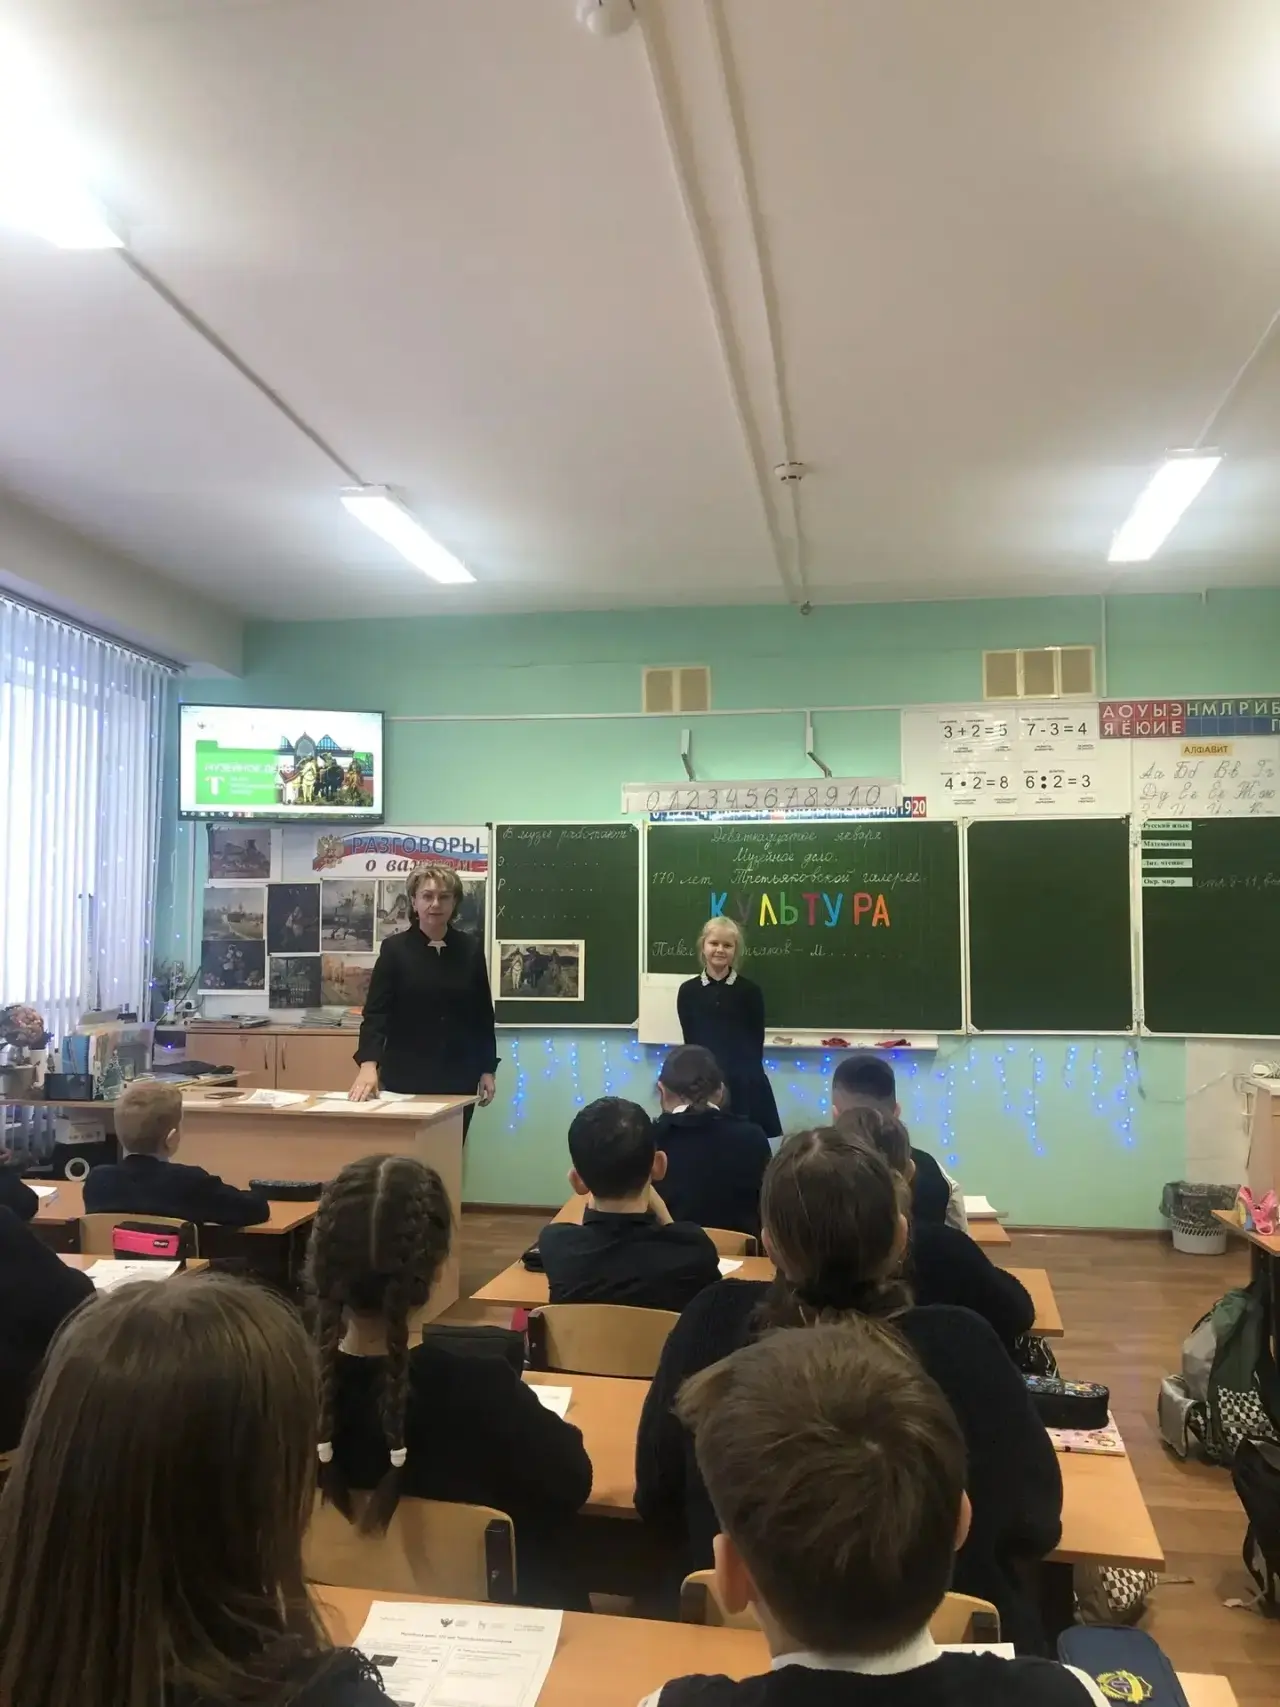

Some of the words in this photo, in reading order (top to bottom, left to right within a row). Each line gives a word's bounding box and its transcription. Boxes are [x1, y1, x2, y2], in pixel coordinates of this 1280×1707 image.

[1102, 705, 1115, 718] А
[1118, 704, 1133, 718] О
[1135, 703, 1149, 717] У
[1153, 703, 1167, 716] Ы
[1171, 703, 1182, 715] Э
[1187, 703, 1199, 716] Н
[1202, 702, 1217, 716] М
[1219, 702, 1232, 715] Л
[1239, 702, 1249, 714] Р
[943, 725, 953, 739] 3
[971, 724, 981, 738] 2
[999, 724, 1008, 737] 5
[1027, 723, 1036, 736] 7
[1050, 722, 1060, 736] 3
[1077, 722, 1088, 735] 4
[1104, 722, 1114, 736] Я
[1122, 720, 1131, 735] Ё
[1136, 721, 1150, 735] Ю
[1153, 721, 1166, 734] И
[1171, 720, 1182, 734] Е
[1184, 745, 1229, 754] АЛФАВИТ
[944, 778, 954, 790] 4
[973, 777, 982, 790] 2
[999, 776, 1009, 789] 8
[1025, 776, 1035, 788] 6
[1053, 775, 1063, 788] 2
[1081, 775, 1091, 788] 3
[647, 790, 660, 811] 0
[669, 790, 679, 810] 1
[685, 790, 700, 809] 2
[705, 789, 718, 809] 3
[726, 789, 738, 808] 4
[745, 788, 758, 808] 5
[764, 788, 778, 808] 6
[784, 787, 798, 808] 7
[804, 787, 818, 807] 8
[825, 786, 838, 806] 9
[913, 801, 926, 815] 20
[352, 837, 480, 854] РАЗГОВОРЫ
[652, 871, 675, 884] 170
[680, 874, 713, 885] лет
[731, 867, 856, 889] Третьяковской
[710, 892, 891, 928] КУЛЬТУРА
